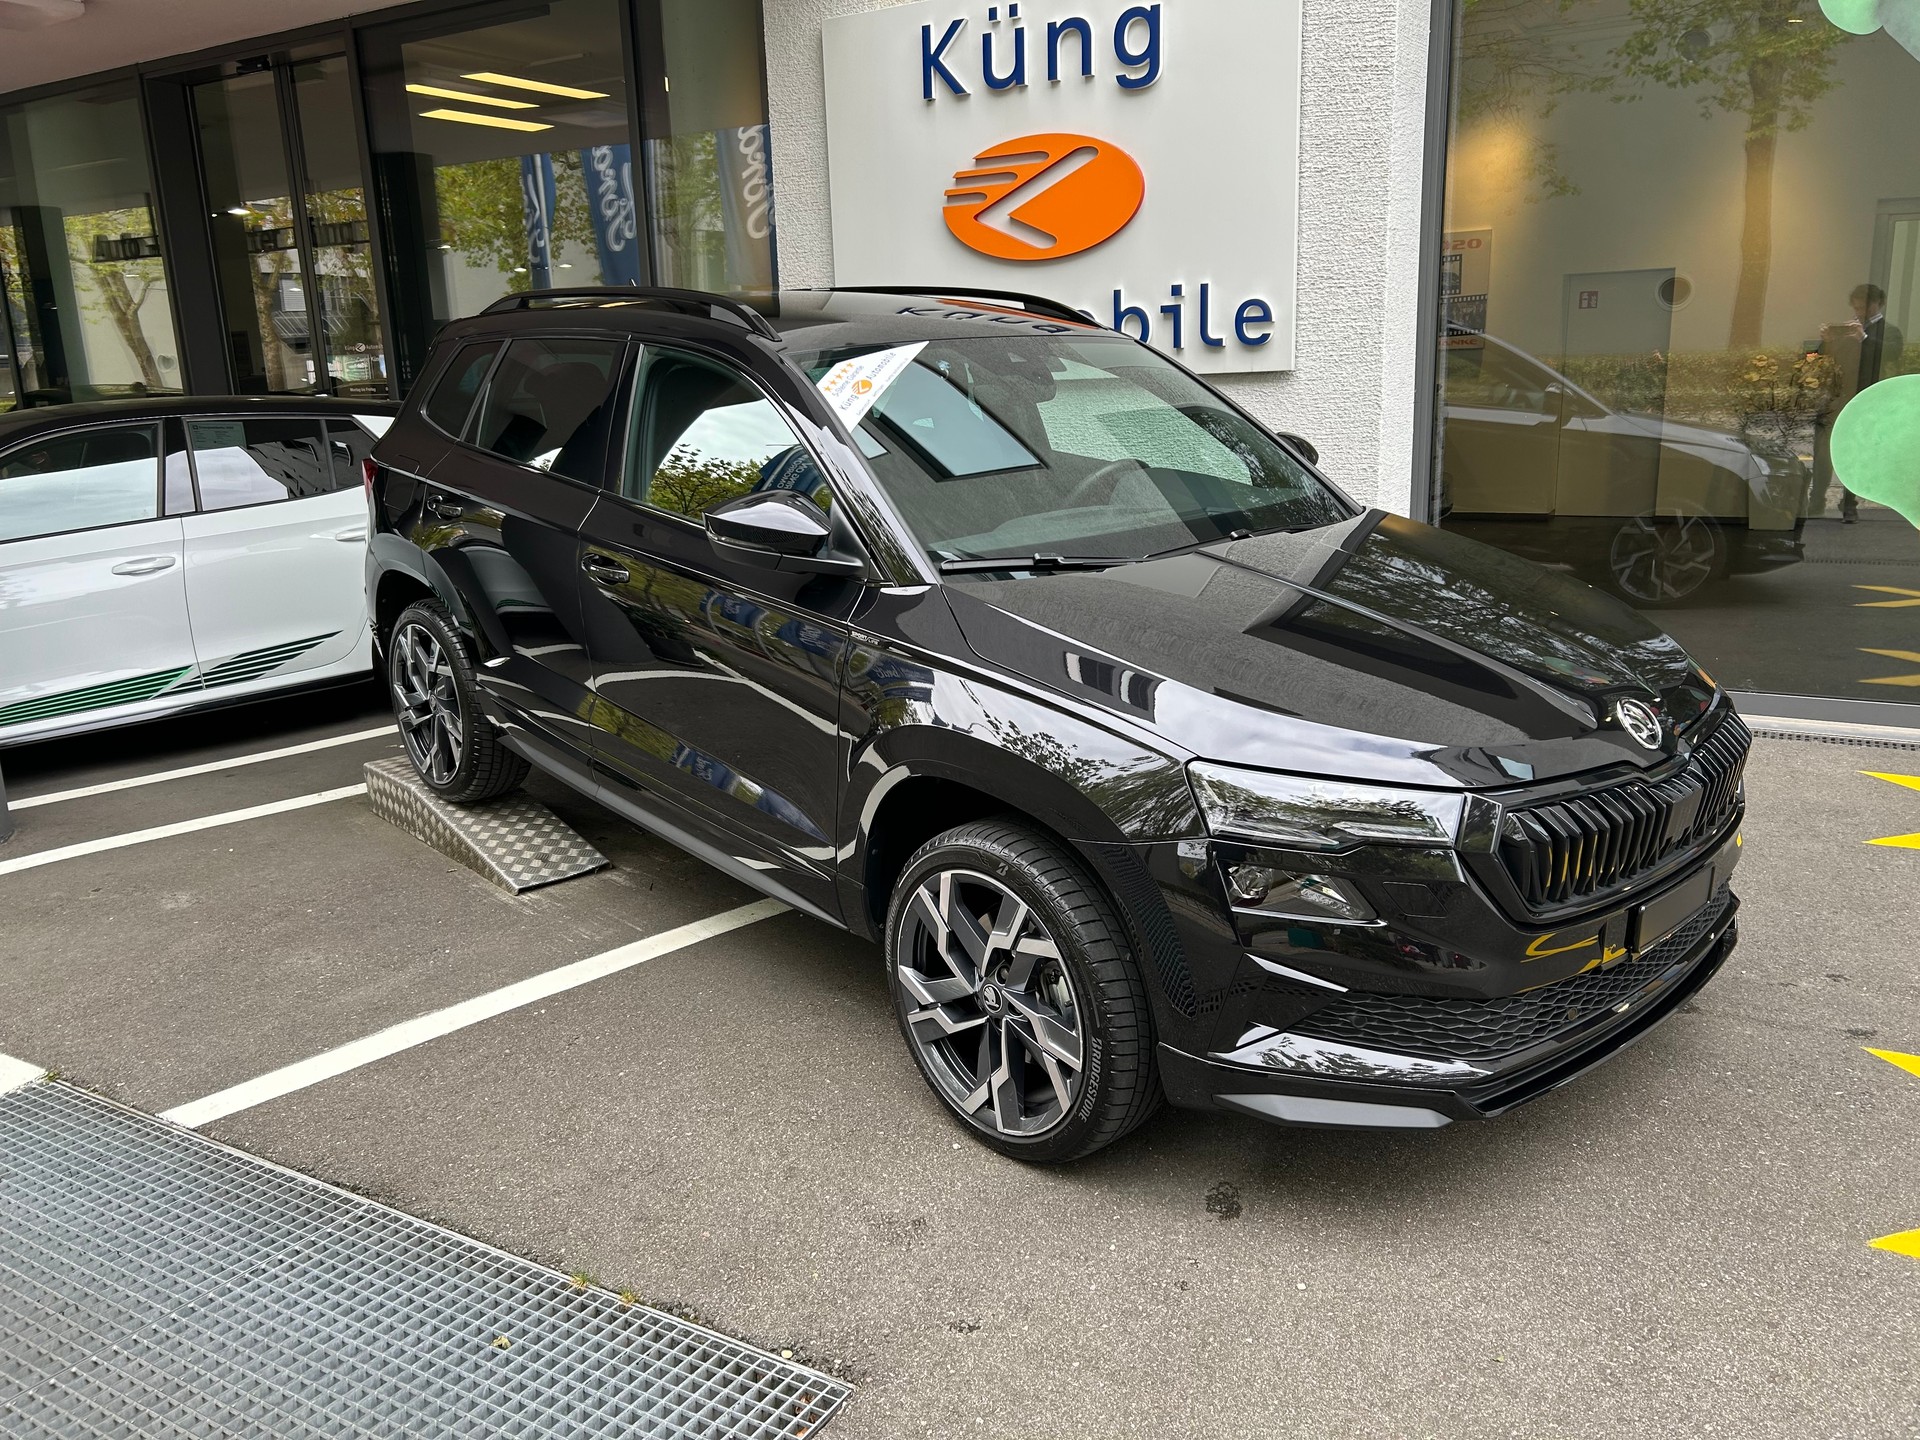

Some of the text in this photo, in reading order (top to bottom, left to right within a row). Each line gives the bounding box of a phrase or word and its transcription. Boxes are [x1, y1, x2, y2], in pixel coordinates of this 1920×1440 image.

[921, 3, 1163, 101] Küng
[1078, 283, 1275, 349] bile
[839, 394, 860, 411] Küng
[866, 351, 897, 380] Automobile
[1078, 1035, 1103, 1123] BRIDGESTONE
